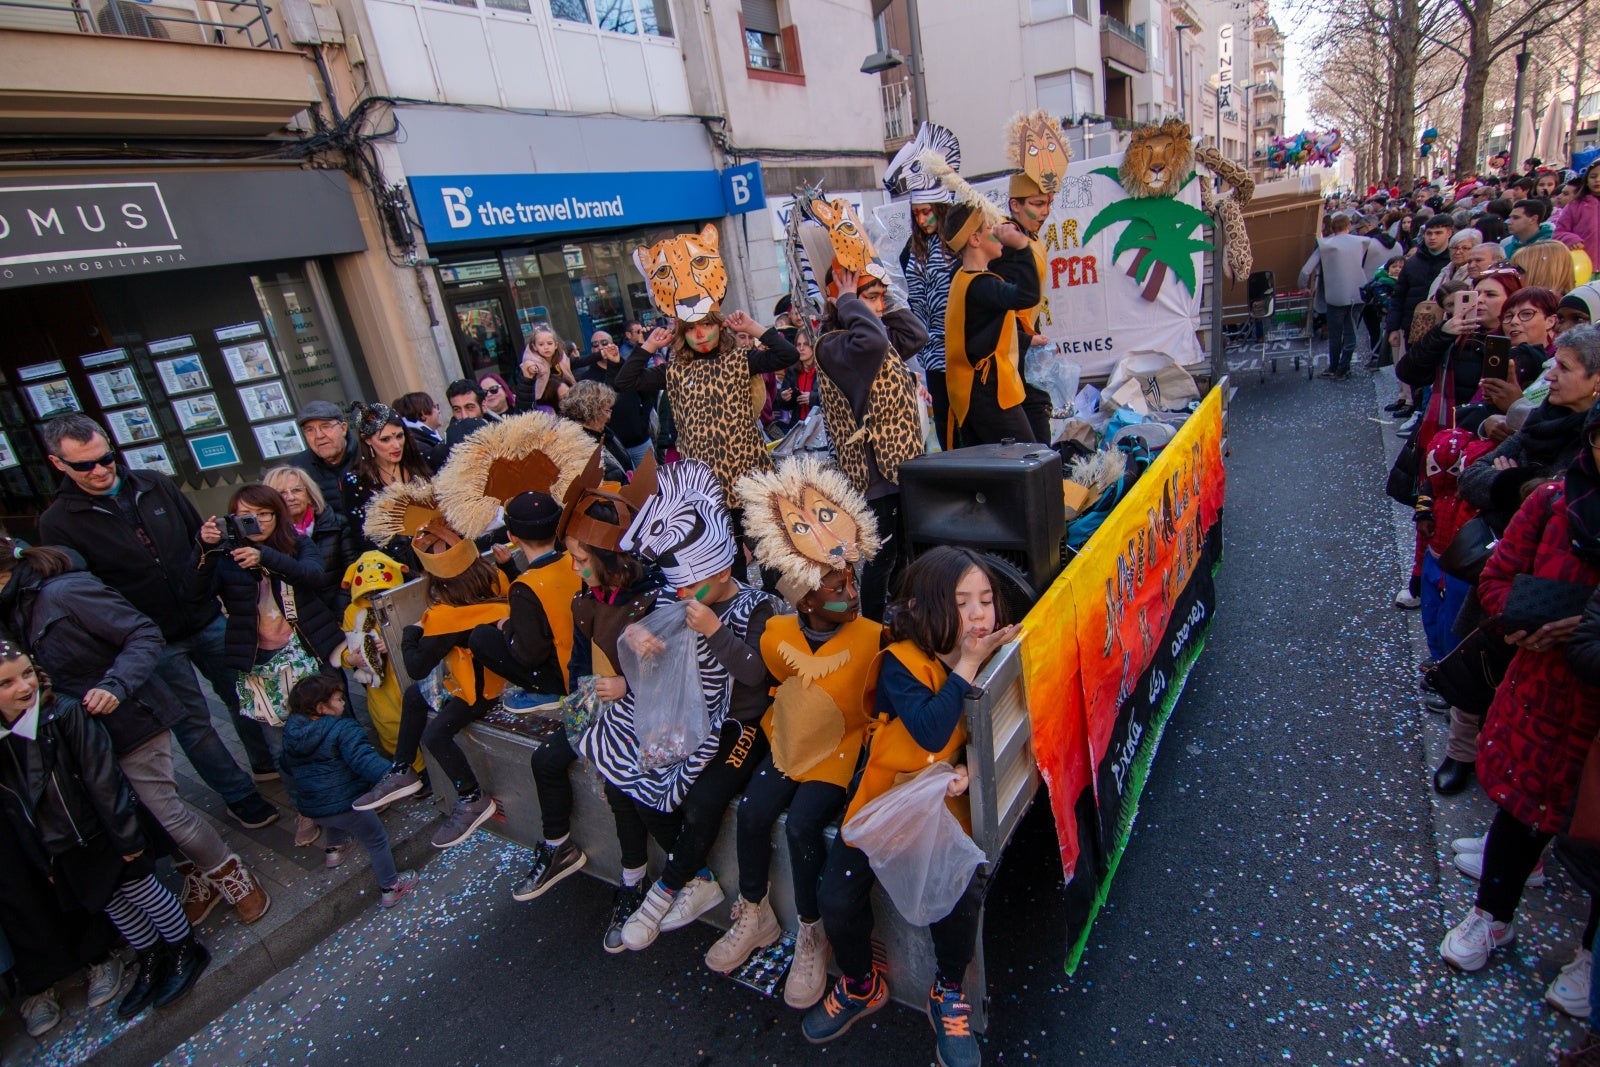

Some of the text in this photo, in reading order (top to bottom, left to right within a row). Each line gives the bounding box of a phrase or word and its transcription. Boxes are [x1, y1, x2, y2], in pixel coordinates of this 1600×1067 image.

[1220, 26, 1232, 109] CINEMA
[478, 201, 515, 226] the
[516, 197, 572, 224] travel
[572, 195, 624, 220] brand
[1050, 255, 1098, 289] PER
[284, 306, 312, 316] LOCALS
[293, 321, 314, 330] PISOS
[297, 335, 319, 344] CASES
[725, 725, 757, 768] TIGER
